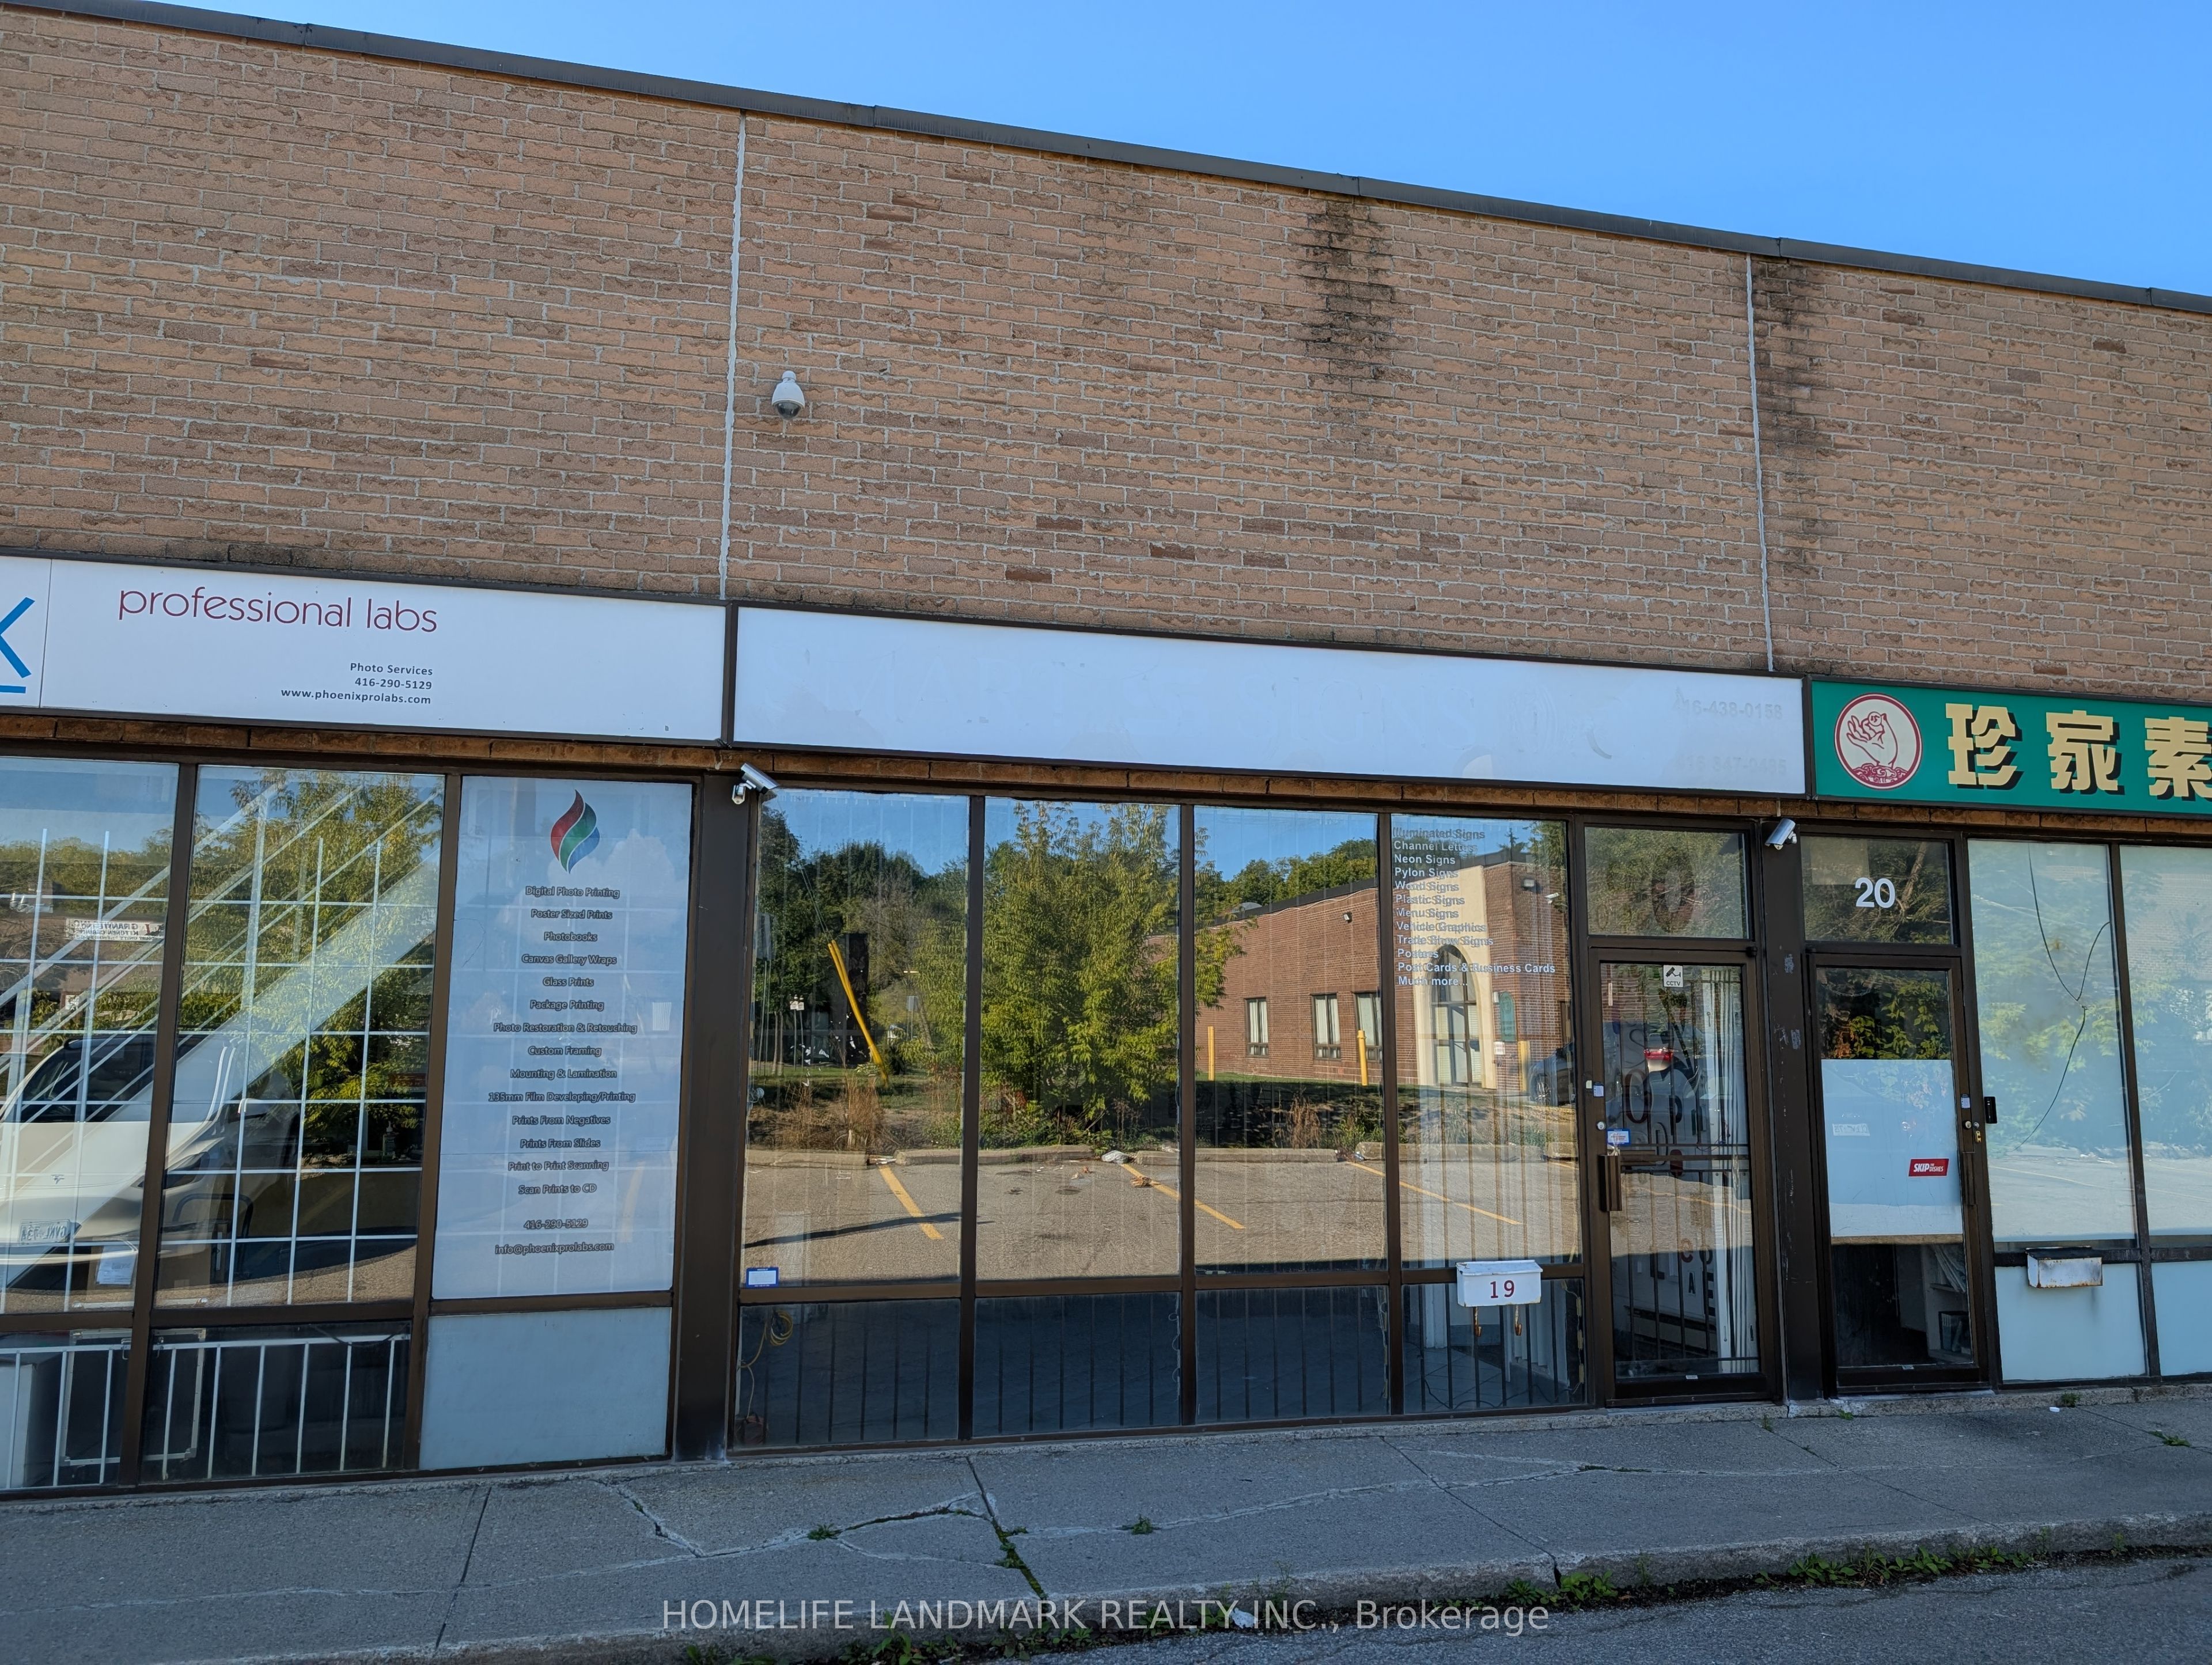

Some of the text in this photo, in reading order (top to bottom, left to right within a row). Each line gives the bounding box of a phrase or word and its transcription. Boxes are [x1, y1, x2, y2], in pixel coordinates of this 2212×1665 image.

[118, 586, 437, 632] professional labs
[350, 662, 433, 676] Photo Services
[355, 676, 433, 690] 416-290-5129
[281, 689, 431, 706] www.phoenixprolabs.com
[1945, 702, 2212, 800] 珍家素
[1455, 829, 1485, 841] Signs
[1394, 840, 1438, 851] Channel
[1395, 855, 1456, 866] Neon Signs
[1395, 867, 1459, 880] Pylon Signs
[525, 886, 620, 898] Digital Photo Printing
[1395, 881, 1460, 893] Wood Signs
[1854, 877, 1896, 908] 20
[1396, 894, 1465, 906] Plastic Signs
[531, 909, 612, 920] Poster Sized Prints
[1426, 909, 1459, 920] Signs
[544, 932, 597, 942] Photobooks
[1427, 936, 1460, 945] Show
[1460, 936, 1494, 947] Signs
[521, 954, 617, 966] Canvas Gallery Wraps
[1398, 962, 1555, 973] Post Cards & Business Cards
[543, 977, 594, 987] Glass Prints
[1399, 976, 1427, 985] Much
[530, 1000, 604, 1011] Package Printing
[494, 1023, 637, 1034] Photo Restoration & Retouching
[528, 1046, 601, 1057] Custom Framing
[510, 1069, 617, 1080] Mounting & Lamination
[488, 1092, 636, 1103] 135mm Film Developing/Printing
[512, 1116, 611, 1127] Prints From Negatives
[520, 1138, 601, 1148] Prints From Slides
[508, 1160, 609, 1171] Print to Print Scanning
[1914, 1163, 1930, 1172] SKIP
[518, 1184, 597, 1194] Scan Prints to CD
[524, 1219, 588, 1230] 416-290-5129
[495, 1242, 614, 1255] info@phoenixprolabs.com
[1490, 1280, 1515, 1299] 19
